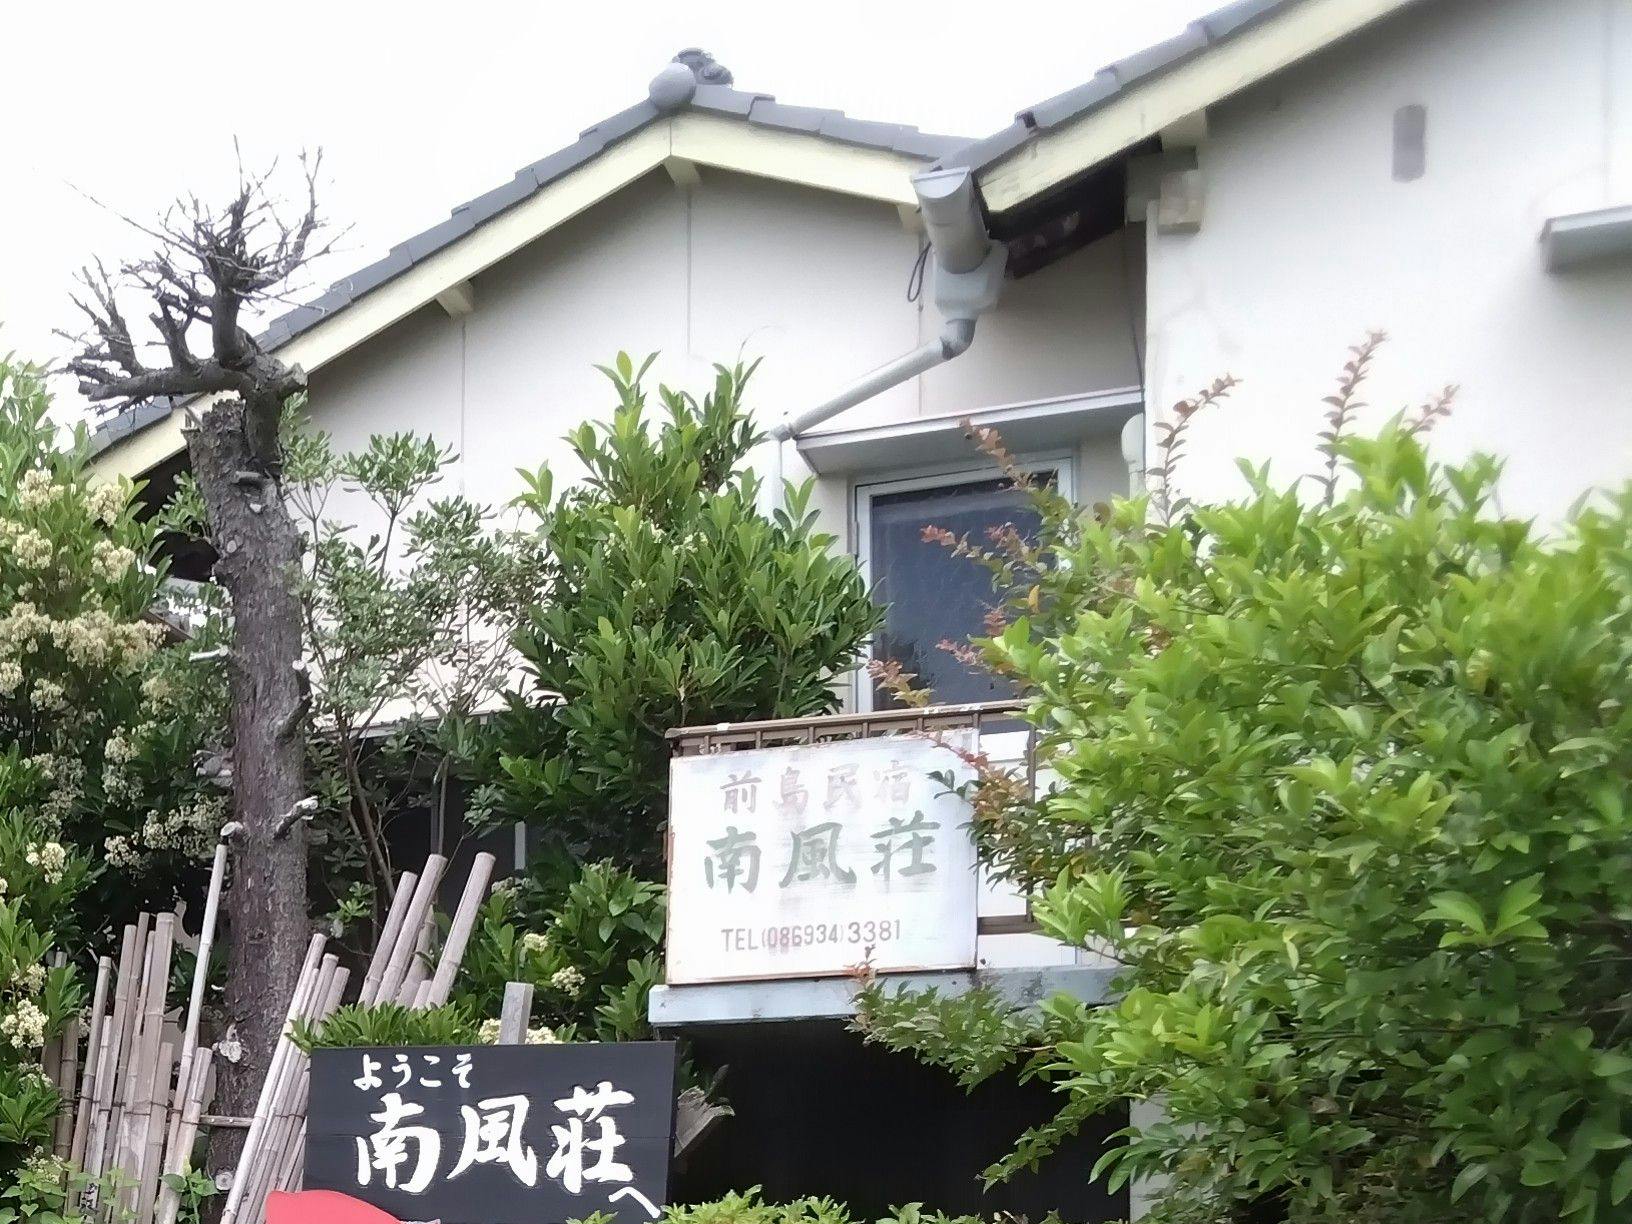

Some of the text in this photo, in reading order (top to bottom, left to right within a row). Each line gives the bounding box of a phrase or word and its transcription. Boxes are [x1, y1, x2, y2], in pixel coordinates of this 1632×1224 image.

[720, 760, 911, 814] 前島民宿
[704, 810, 941, 893] 南風荘
[353, 1053, 474, 1089] ようこそ
